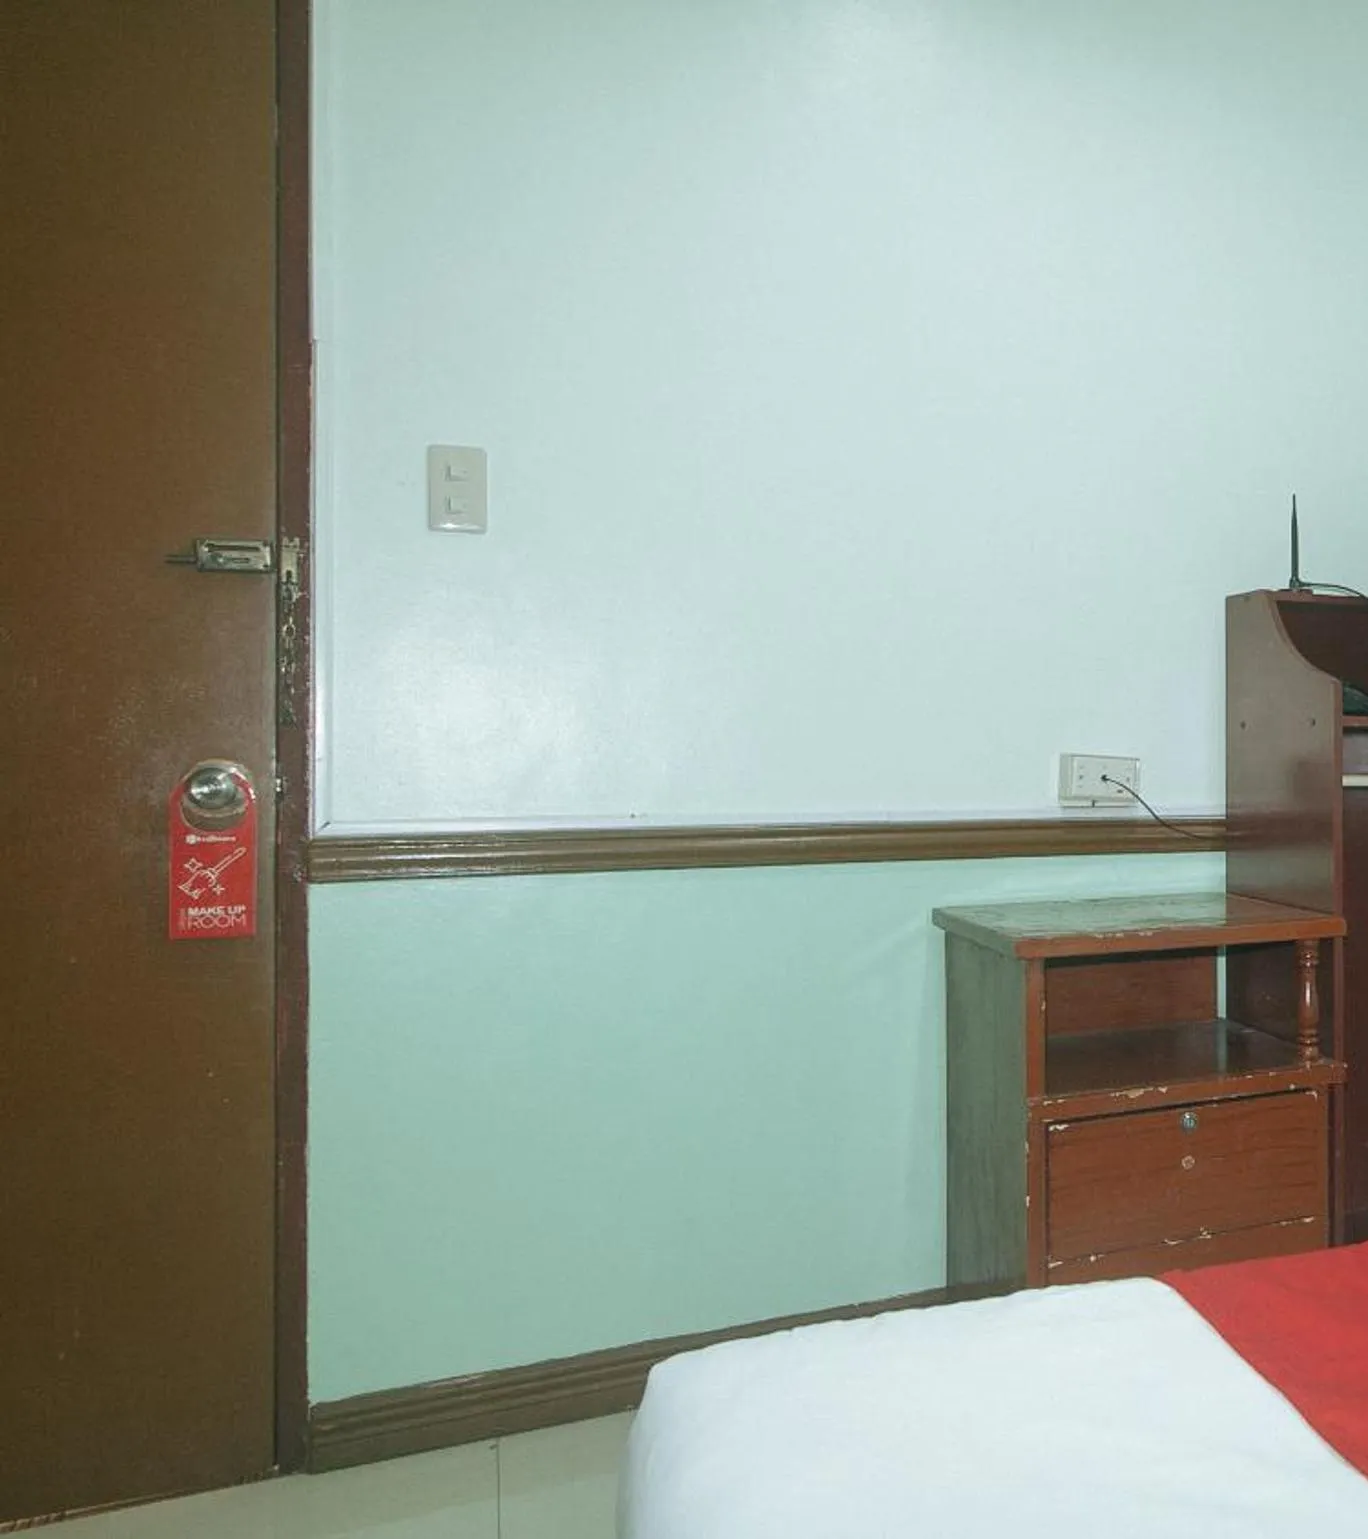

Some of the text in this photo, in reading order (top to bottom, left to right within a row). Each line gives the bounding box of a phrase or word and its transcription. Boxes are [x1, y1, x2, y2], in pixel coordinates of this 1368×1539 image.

[188, 904, 246, 915] MAKE UP
[187, 914, 247, 929] ROOM
